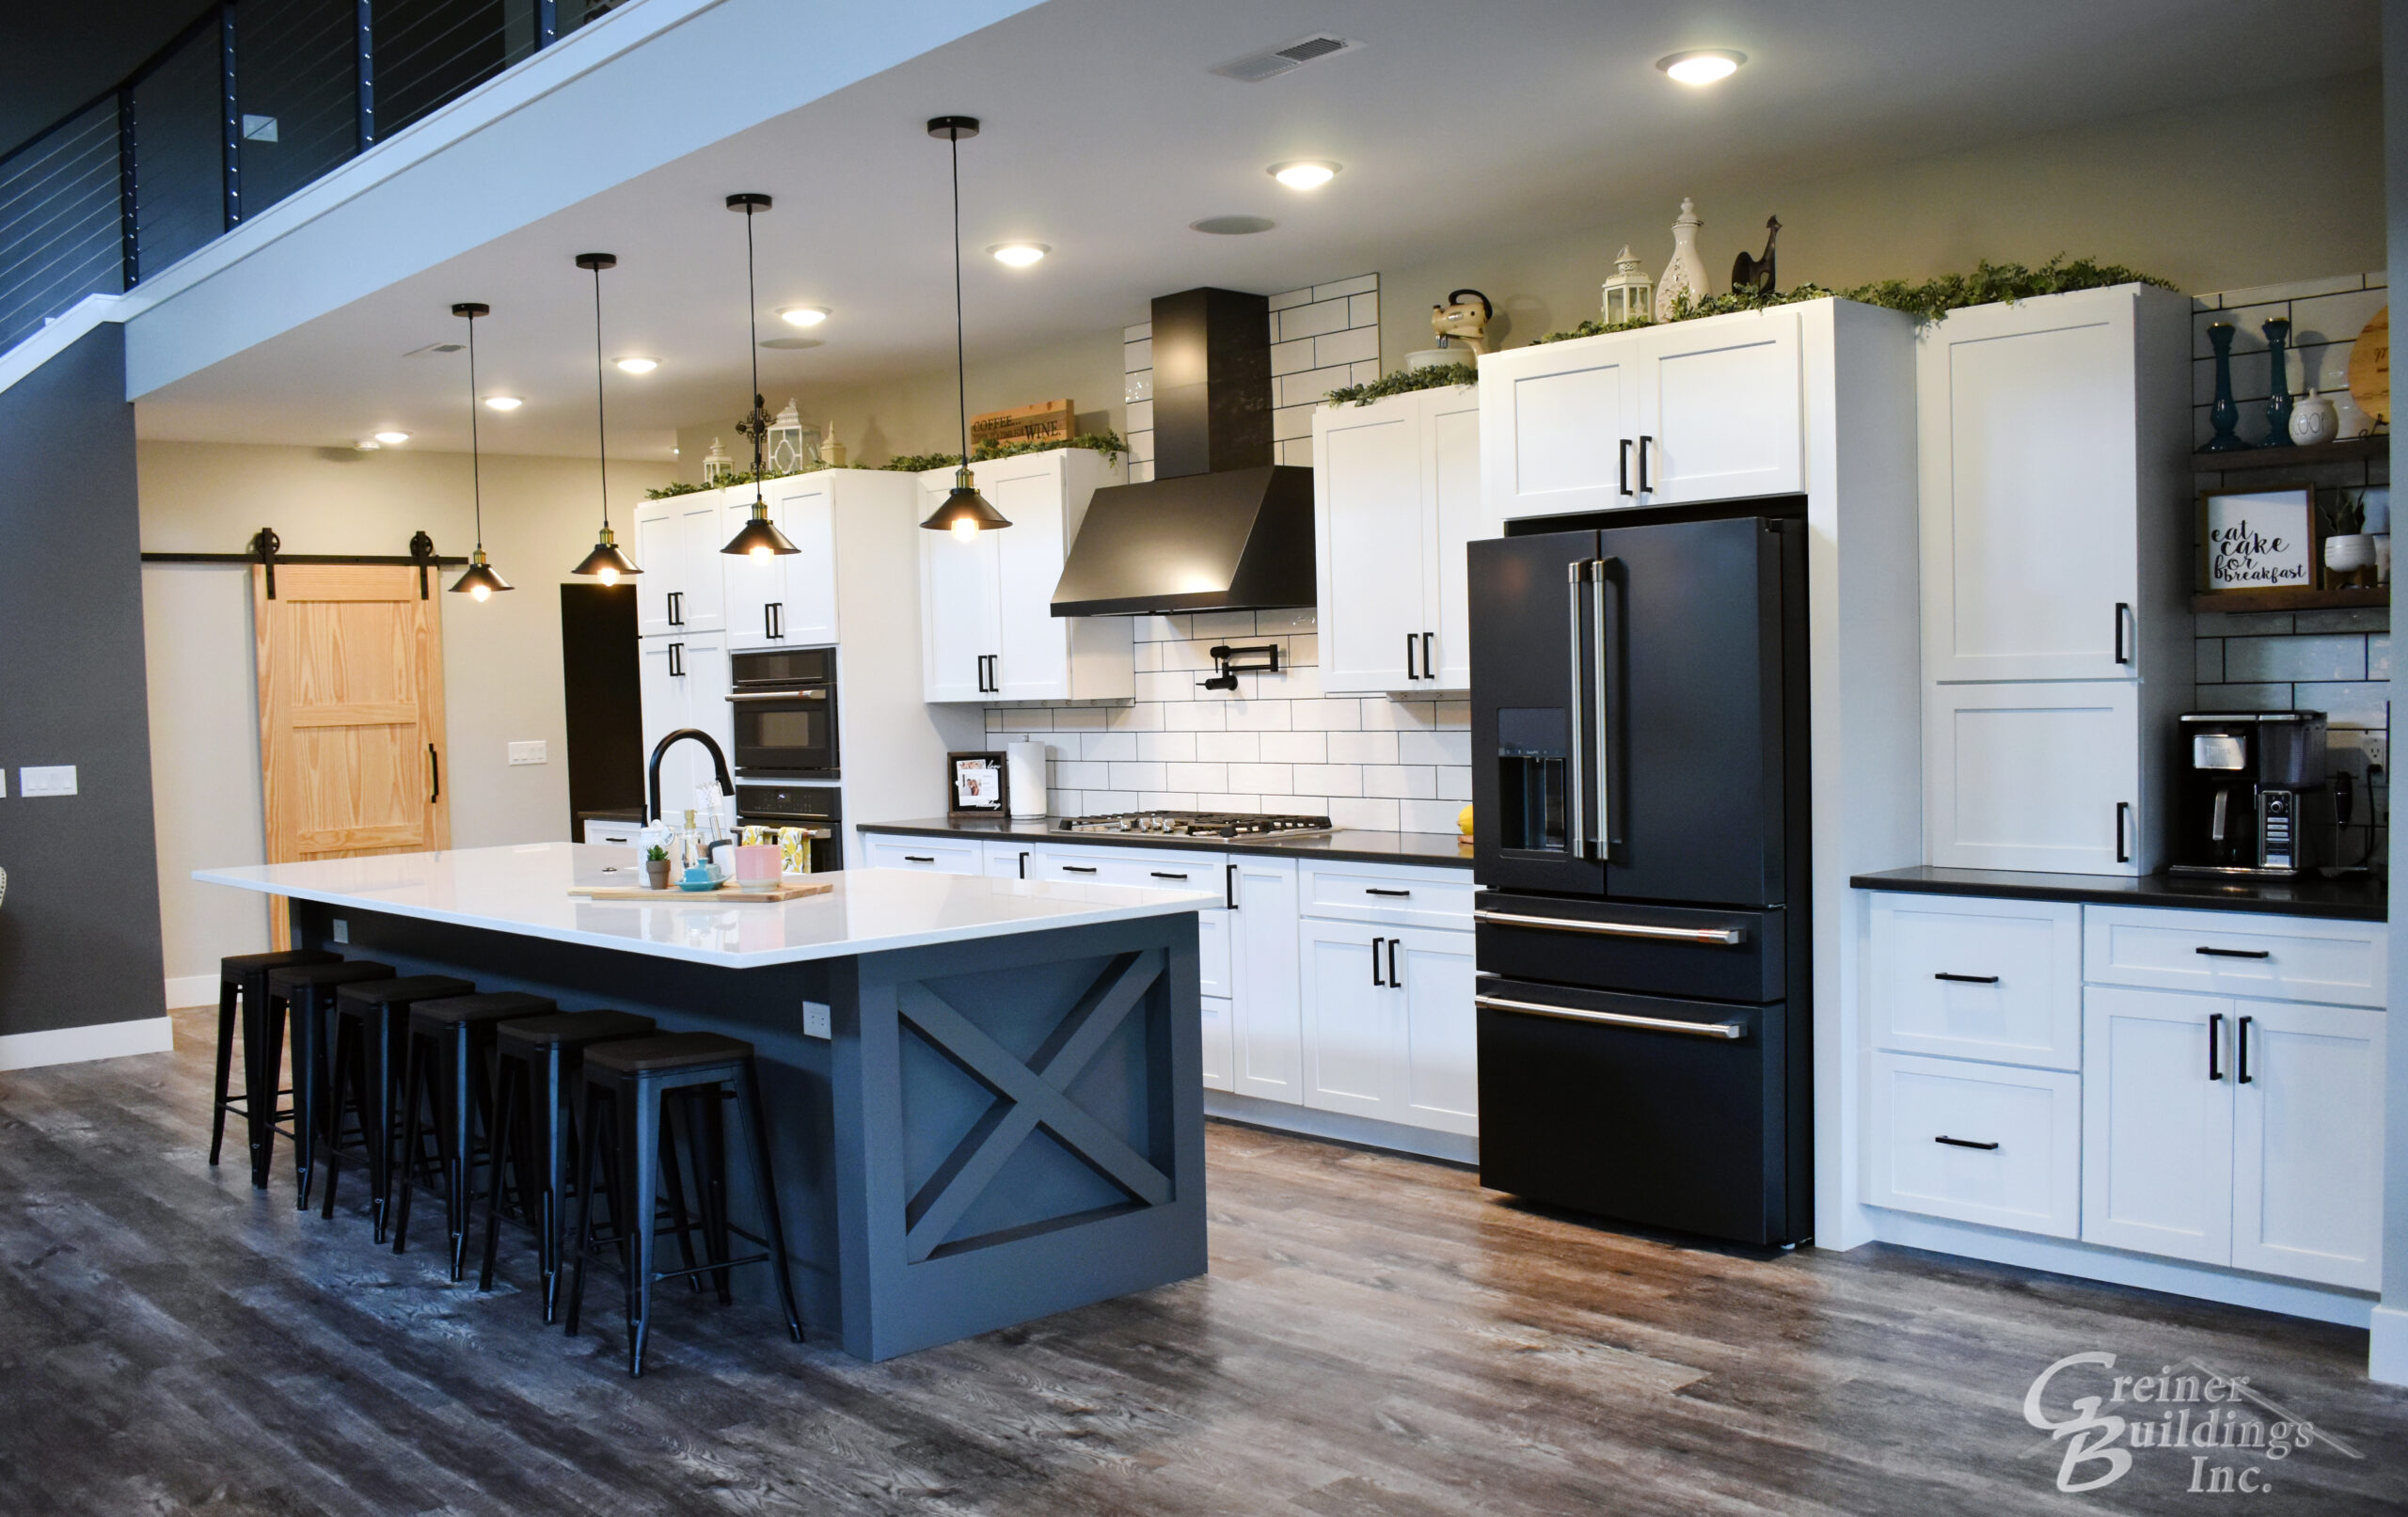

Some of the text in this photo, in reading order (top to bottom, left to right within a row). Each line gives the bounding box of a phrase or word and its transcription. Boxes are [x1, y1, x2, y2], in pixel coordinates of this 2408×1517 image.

[2211, 519, 2254, 542] eat
[2220, 532, 2289, 556] cake
[2214, 554, 2258, 579] for
[2224, 564, 2306, 583] breakfast
